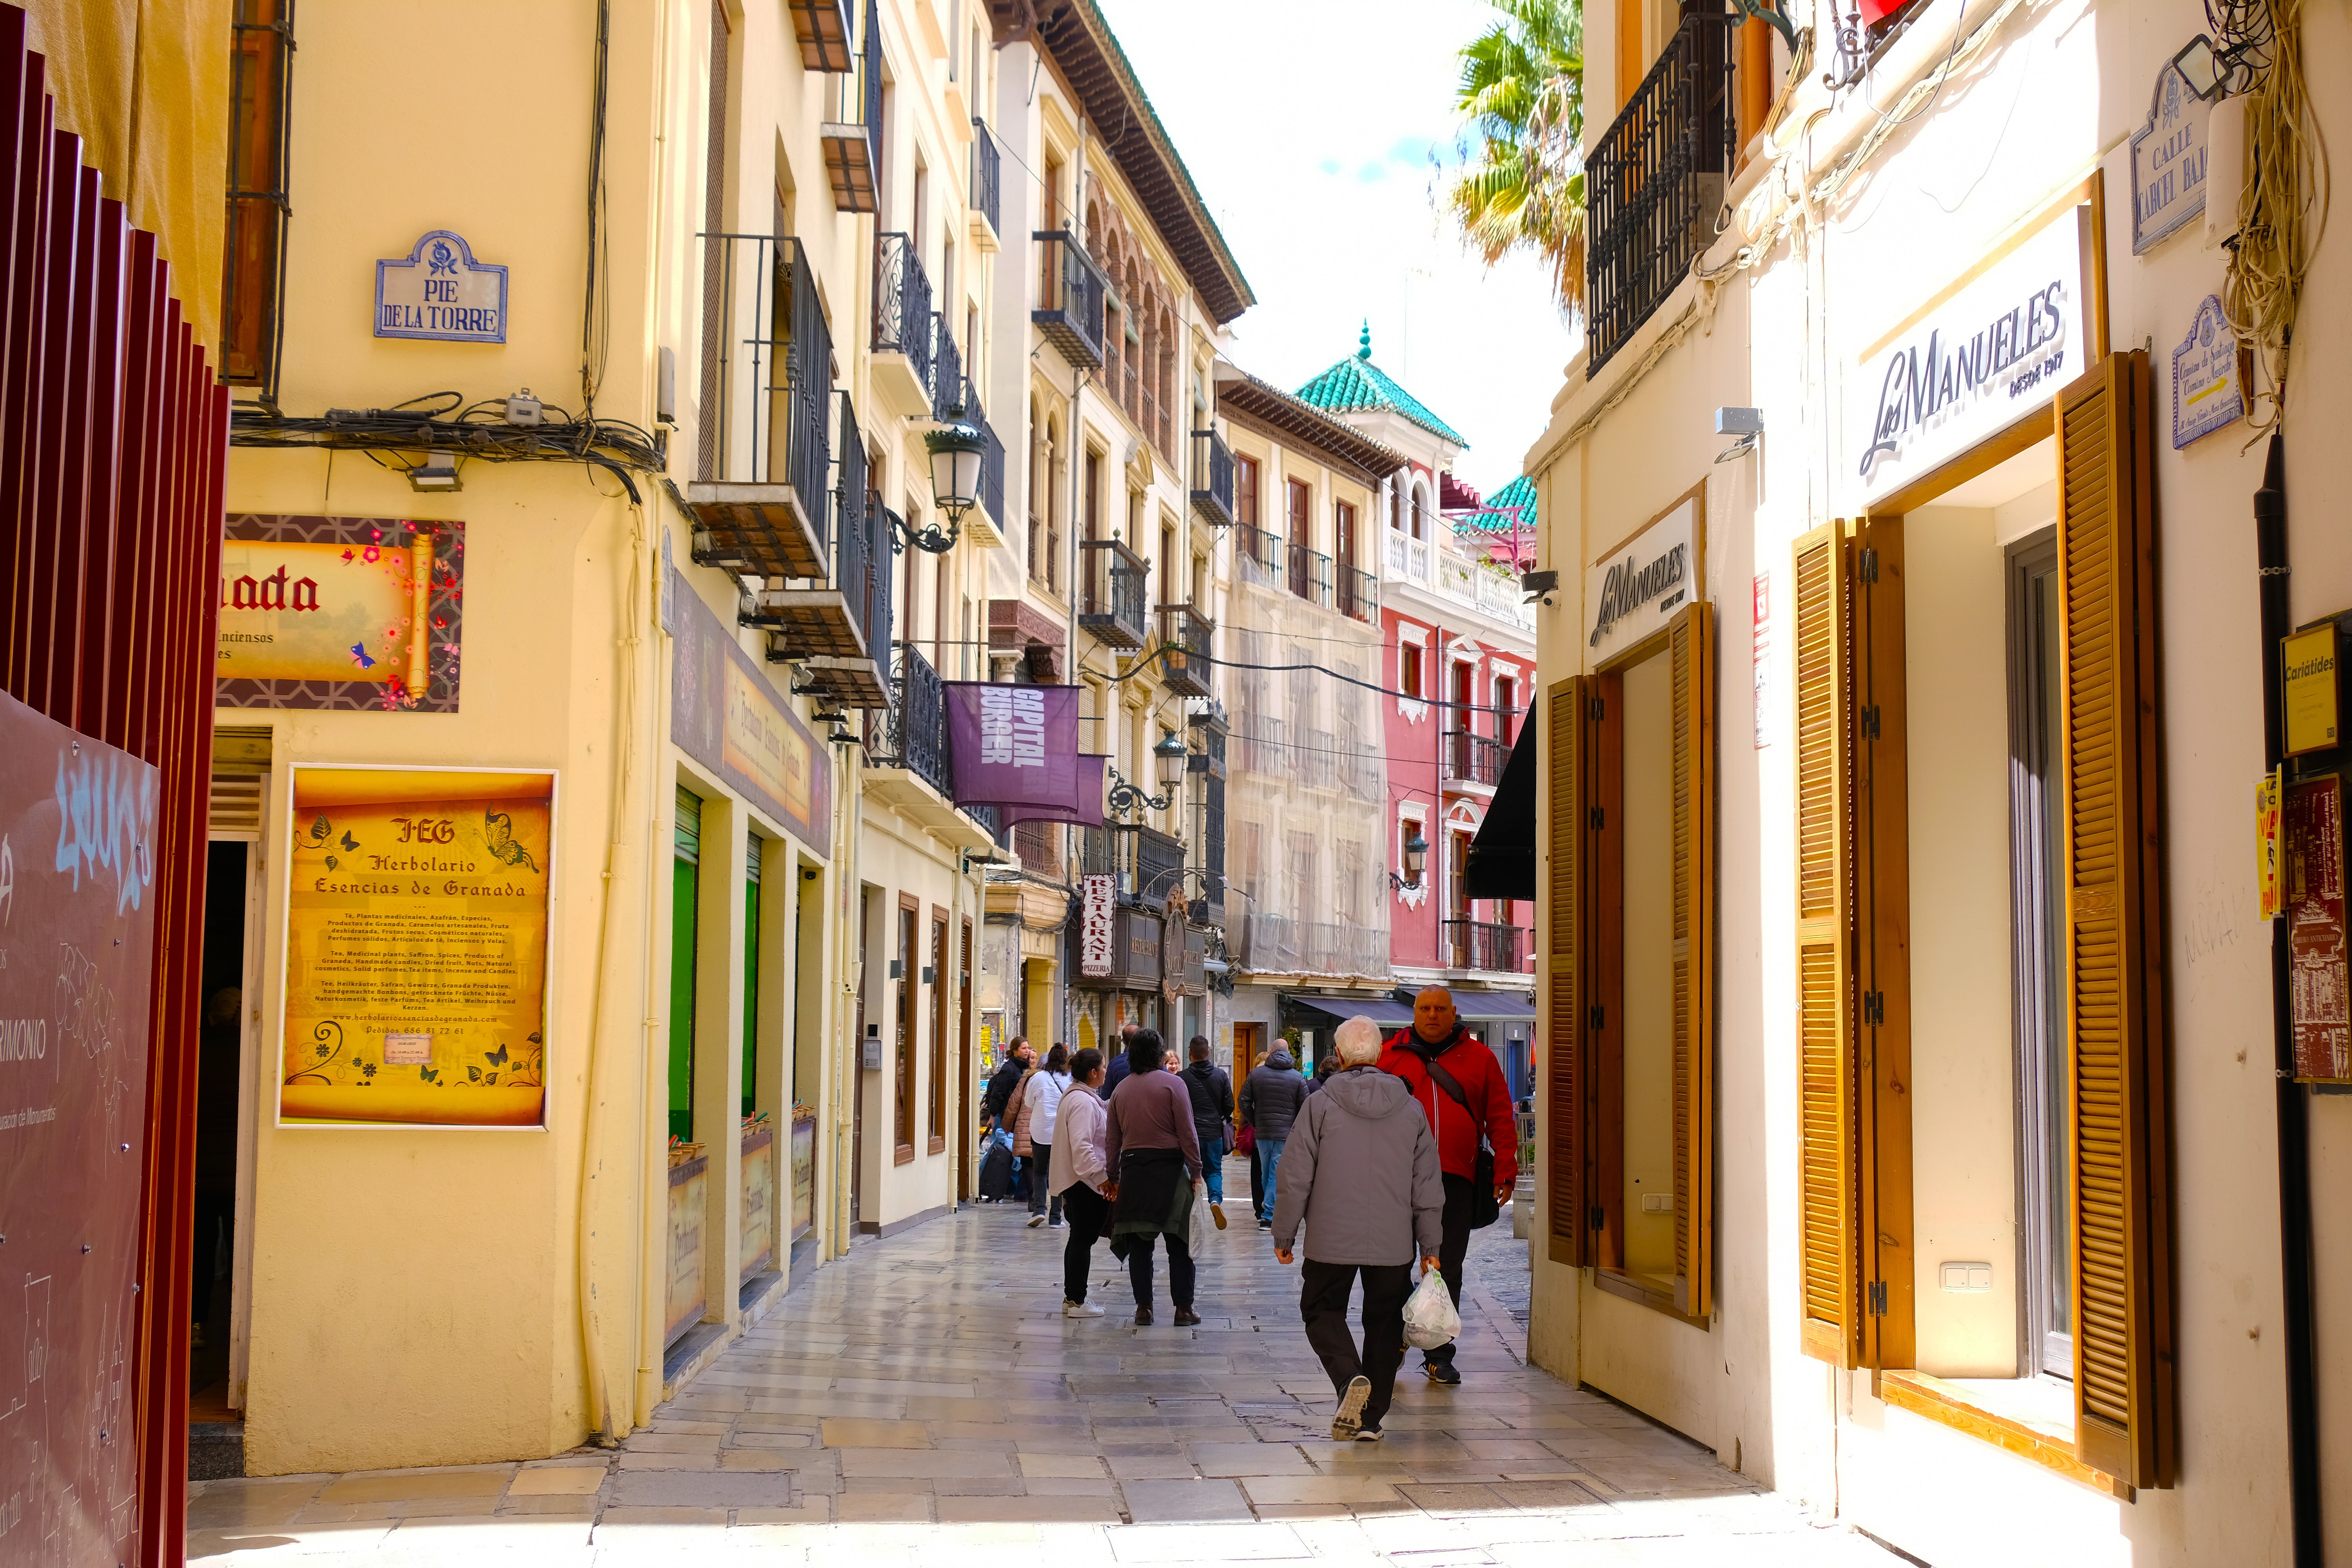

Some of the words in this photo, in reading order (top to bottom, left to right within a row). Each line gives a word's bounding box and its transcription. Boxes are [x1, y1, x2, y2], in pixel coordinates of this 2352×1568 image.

[2152, 122, 2192, 171] CALLE
[2139, 169, 2176, 225] CARCEL
[423, 279, 458, 303] PIE
[383, 305, 402, 327] DE
[404, 305, 423, 328] LA
[428, 305, 497, 332] TORRE
[2180, 362, 2200, 380] Camino
[2202, 350, 2208, 368] de
[2210, 341, 2234, 364] Santiago
[2009, 364, 2041, 400] DESDE
[2043, 350, 2063, 377] 1917
[1859, 350, 1905, 476] Los
[1660, 594, 1675, 613] DESDE
[218, 630, 273, 643] nciensos
[2285, 655, 2334, 682] Cariátides
[980, 685, 1013, 764] BURGER
[1013, 689, 1045, 768] CAPITAL
[367, 855, 475, 872] Herbolario
[315, 878, 399, 894] Esencias
[412, 880, 431, 895] de
[443, 880, 525, 897] Granada
[1089, 879, 1108, 960] RESTAURANT
[2310, 933, 2338, 942] ANTICUARIO
[1084, 964, 1110, 972] PIZZERIA
[332, 1014, 497, 1023] www.herbolarioesenciasdegranada.com
[18, 1108, 25, 1127] de
[26, 1105, 56, 1125] Monumentos
